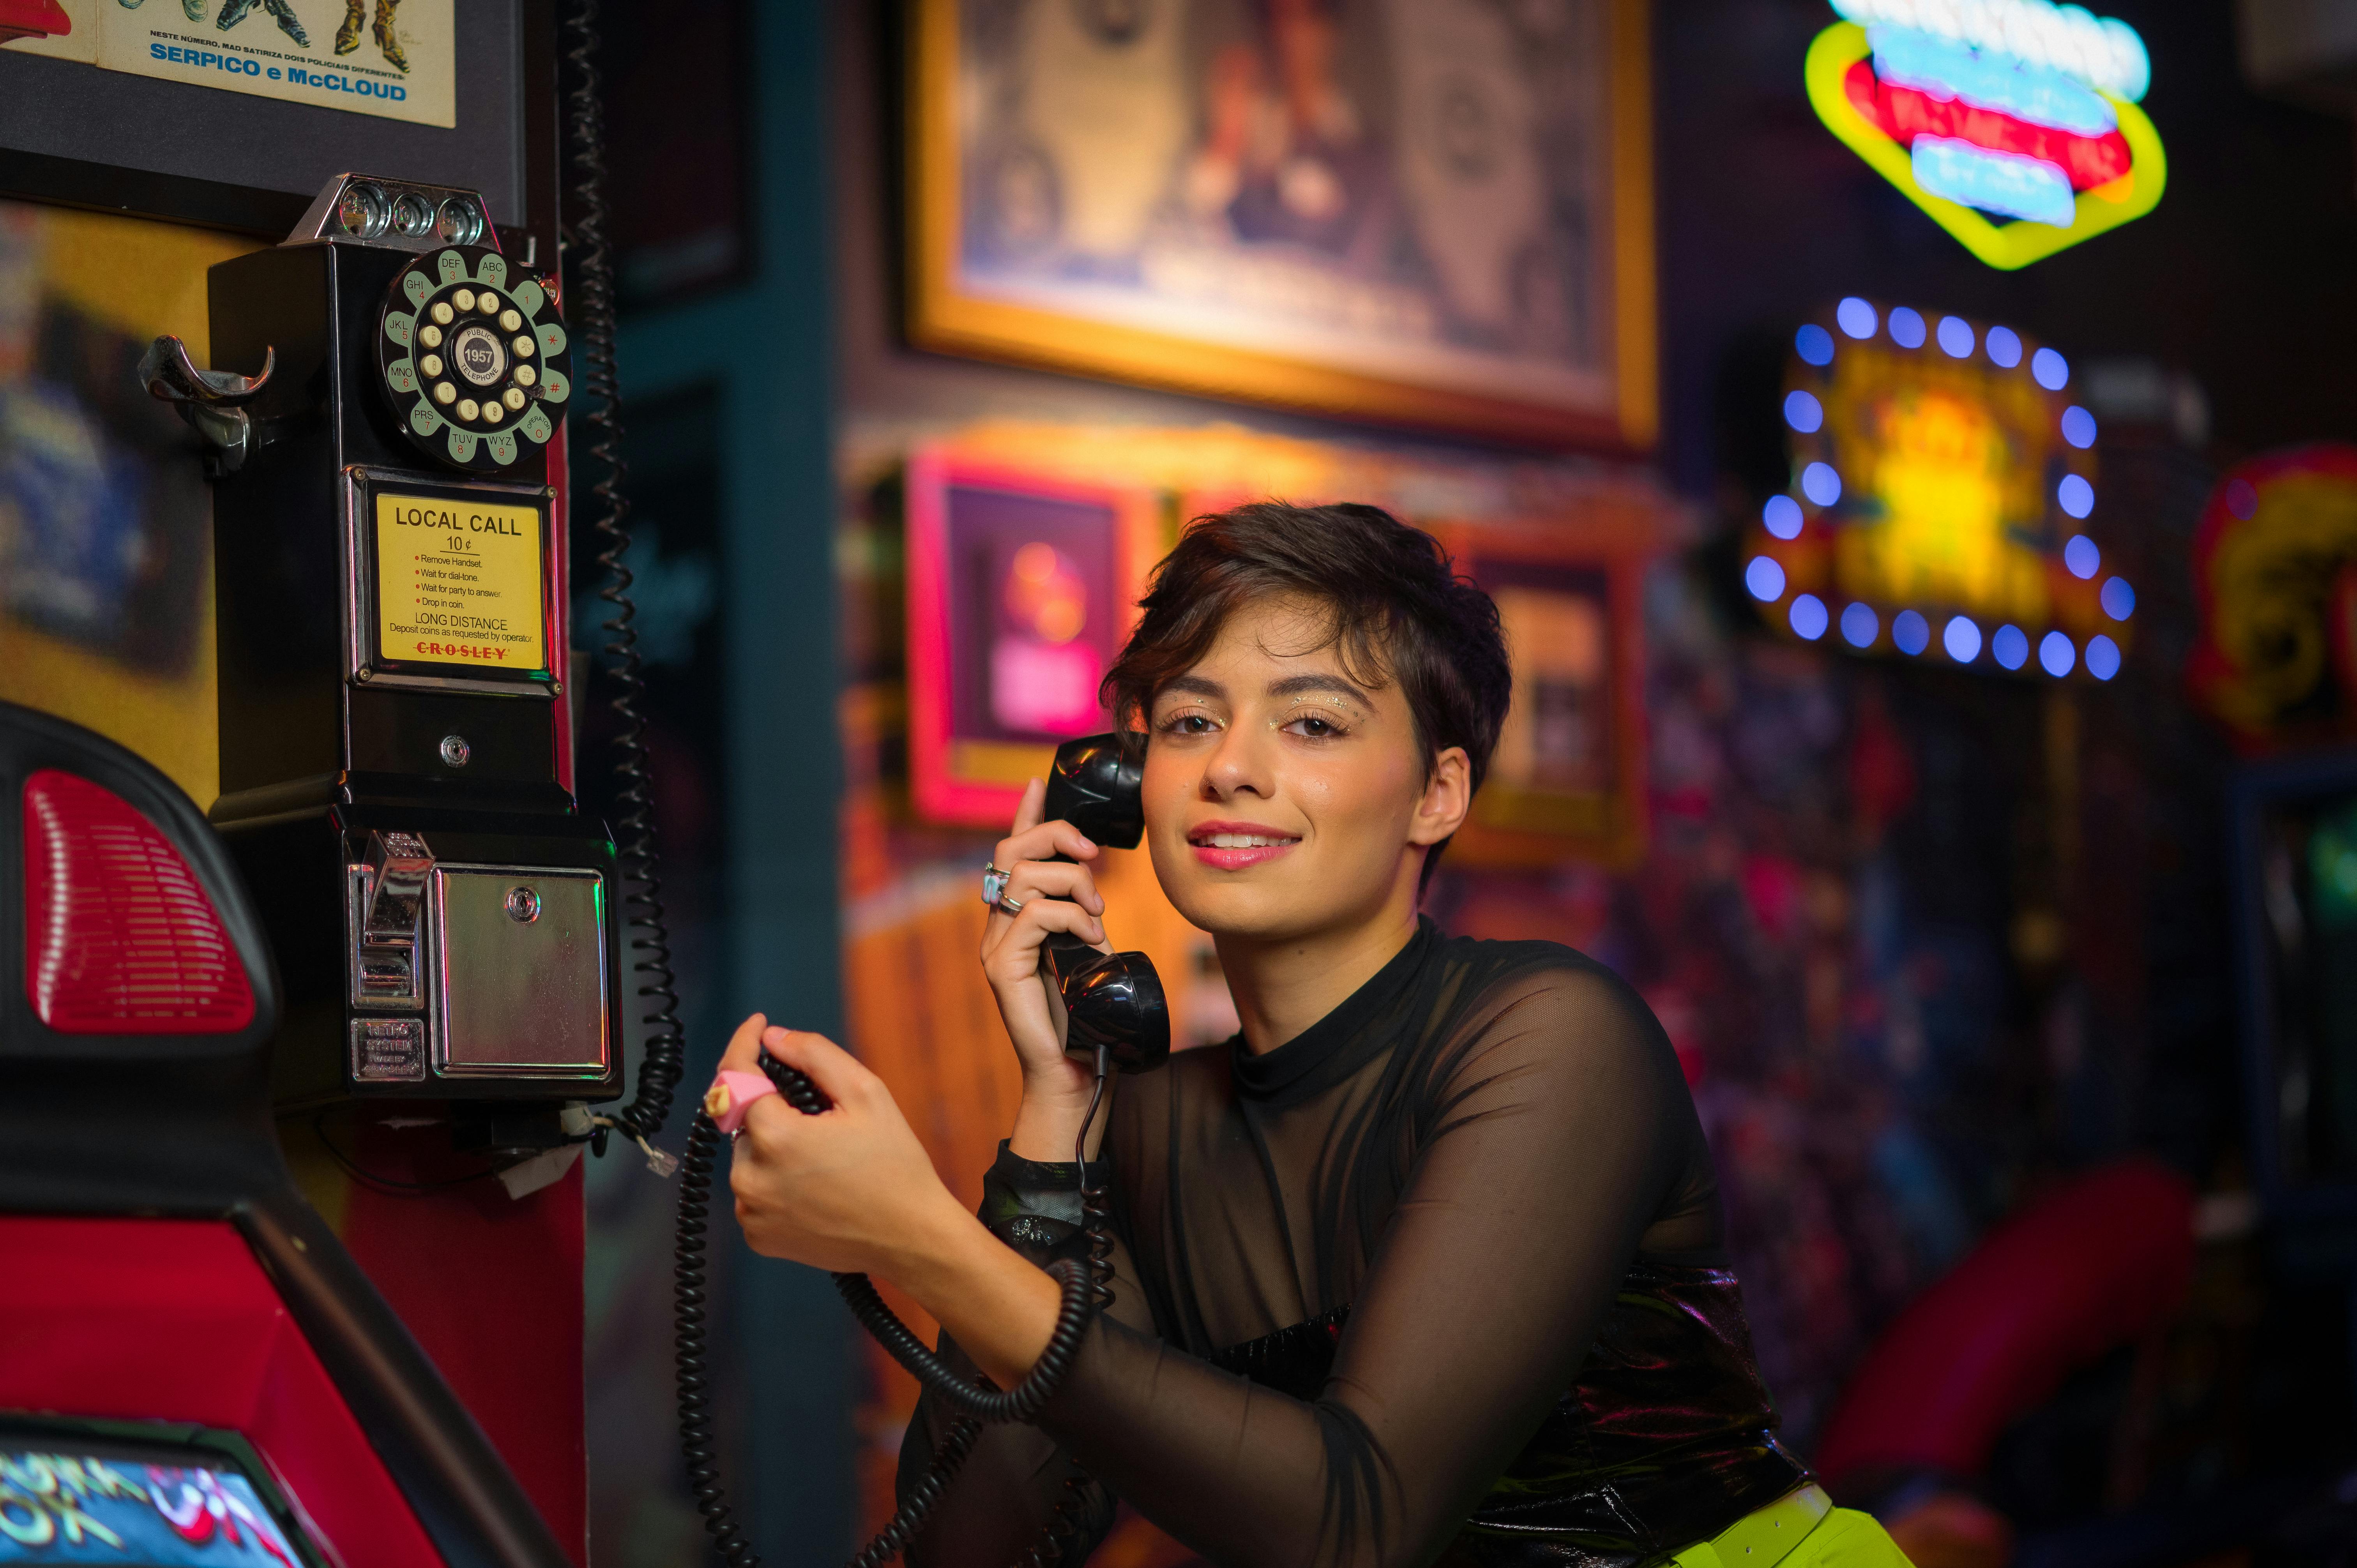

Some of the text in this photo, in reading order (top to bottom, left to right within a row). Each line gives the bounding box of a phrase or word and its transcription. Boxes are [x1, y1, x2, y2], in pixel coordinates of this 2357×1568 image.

[150, 30, 179, 40] NESTE
[180, 35, 220, 48] NÚMERO,
[222, 43, 241, 51] MAD
[243, 47, 282, 58] SATIRIZA
[284, 54, 306, 63] DOIS
[307, 58, 350, 71] POLICIAIS
[150, 43, 407, 102] SERPICO e McCLOUD
[442, 258, 461, 268] DEF
[482, 262, 502, 272] ABC
[450, 271, 456, 280] 3
[489, 274, 495, 283] 2
[406, 279, 423, 290] GHI
[419, 291, 424, 299] 4
[465, 295, 469, 305] 3
[525, 296, 529, 304] 1
[489, 298, 493, 307] 2
[443, 308, 448, 318] 4
[390, 320, 408, 330] JKL
[511, 315, 514, 325] 1
[402, 331, 408, 340] 5
[432, 331, 436, 341] 5
[466, 329, 492, 341] PUBLIC
[465, 349, 493, 363] 1957
[432, 360, 436, 370] 6
[391, 367, 413, 377] MNO
[461, 363, 499, 381] TELEPHONE
[403, 378, 409, 387] 6
[445, 387, 449, 397] 7
[514, 394, 518, 403] 0
[468, 404, 473, 414] 8
[493, 407, 497, 417] 9
[414, 410, 433, 420] PRS
[425, 421, 430, 430] 7
[527, 416, 551, 430] OPERATOR
[452, 433, 472, 443] TUV
[488, 436, 512, 446] WYZ
[458, 445, 463, 454] 8
[498, 448, 504, 456] 9
[396, 507, 522, 536] LOCAL CALL
[447, 535, 472, 551] 10 ¢
[421, 554, 482, 568] Remove Handset.
[421, 569, 479, 582] Wait for dial-tone.
[421, 583, 437, 592] Wait
[439, 584, 447, 593] for
[449, 586, 466, 597] party
[476, 589, 502, 598] answer.
[422, 597, 465, 609] Drop in coin.
[416, 612, 508, 630] LONG DISTANCE
[390, 623, 419, 634] Deposit
[420, 627, 440, 635] coins
[452, 630, 489, 639] requested
[491, 632, 500, 642] by
[502, 634, 534, 643] operator.
[416, 642, 507, 660] CROSLEY
[368, 1025, 409, 1037] RETRO
[366, 1039, 412, 1052] SYSTEM
